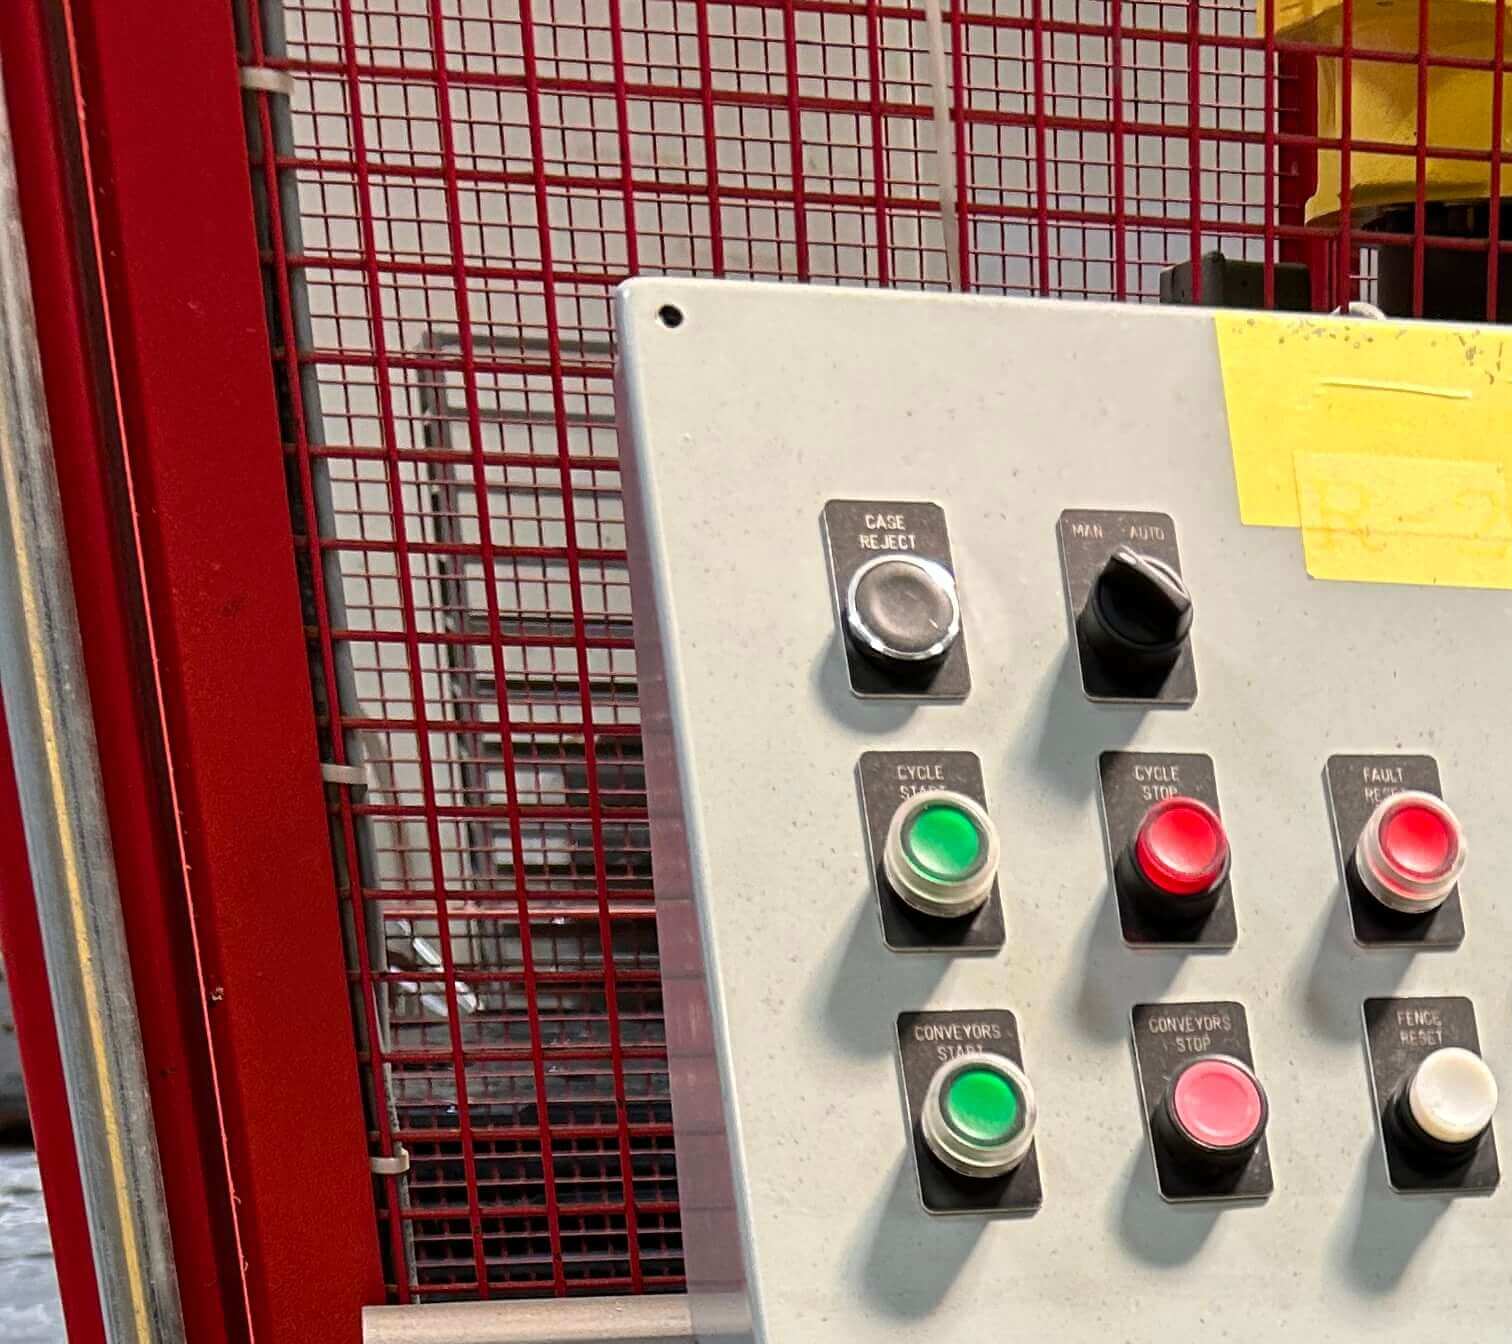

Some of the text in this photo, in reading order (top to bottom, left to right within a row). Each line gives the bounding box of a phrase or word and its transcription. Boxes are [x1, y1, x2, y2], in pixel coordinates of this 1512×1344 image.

[865, 514, 906, 530] CASE
[1072, 524, 1104, 539] MAN
[1130, 525, 1165, 541] AUTO
[860, 534, 917, 550] REJECT
[897, 764, 945, 780] CYCLE
[1135, 765, 1180, 782] CYCLE
[1363, 766, 1403, 783] FAULT
[1143, 785, 1179, 801] STOP
[1148, 1015, 1231, 1034] CONVEYORS
[1397, 1010, 1442, 1027] FENCE
[914, 1023, 1001, 1041] CONVEYORS
[1400, 1030, 1443, 1047] RESET
[1175, 1036, 1212, 1053] STOP
